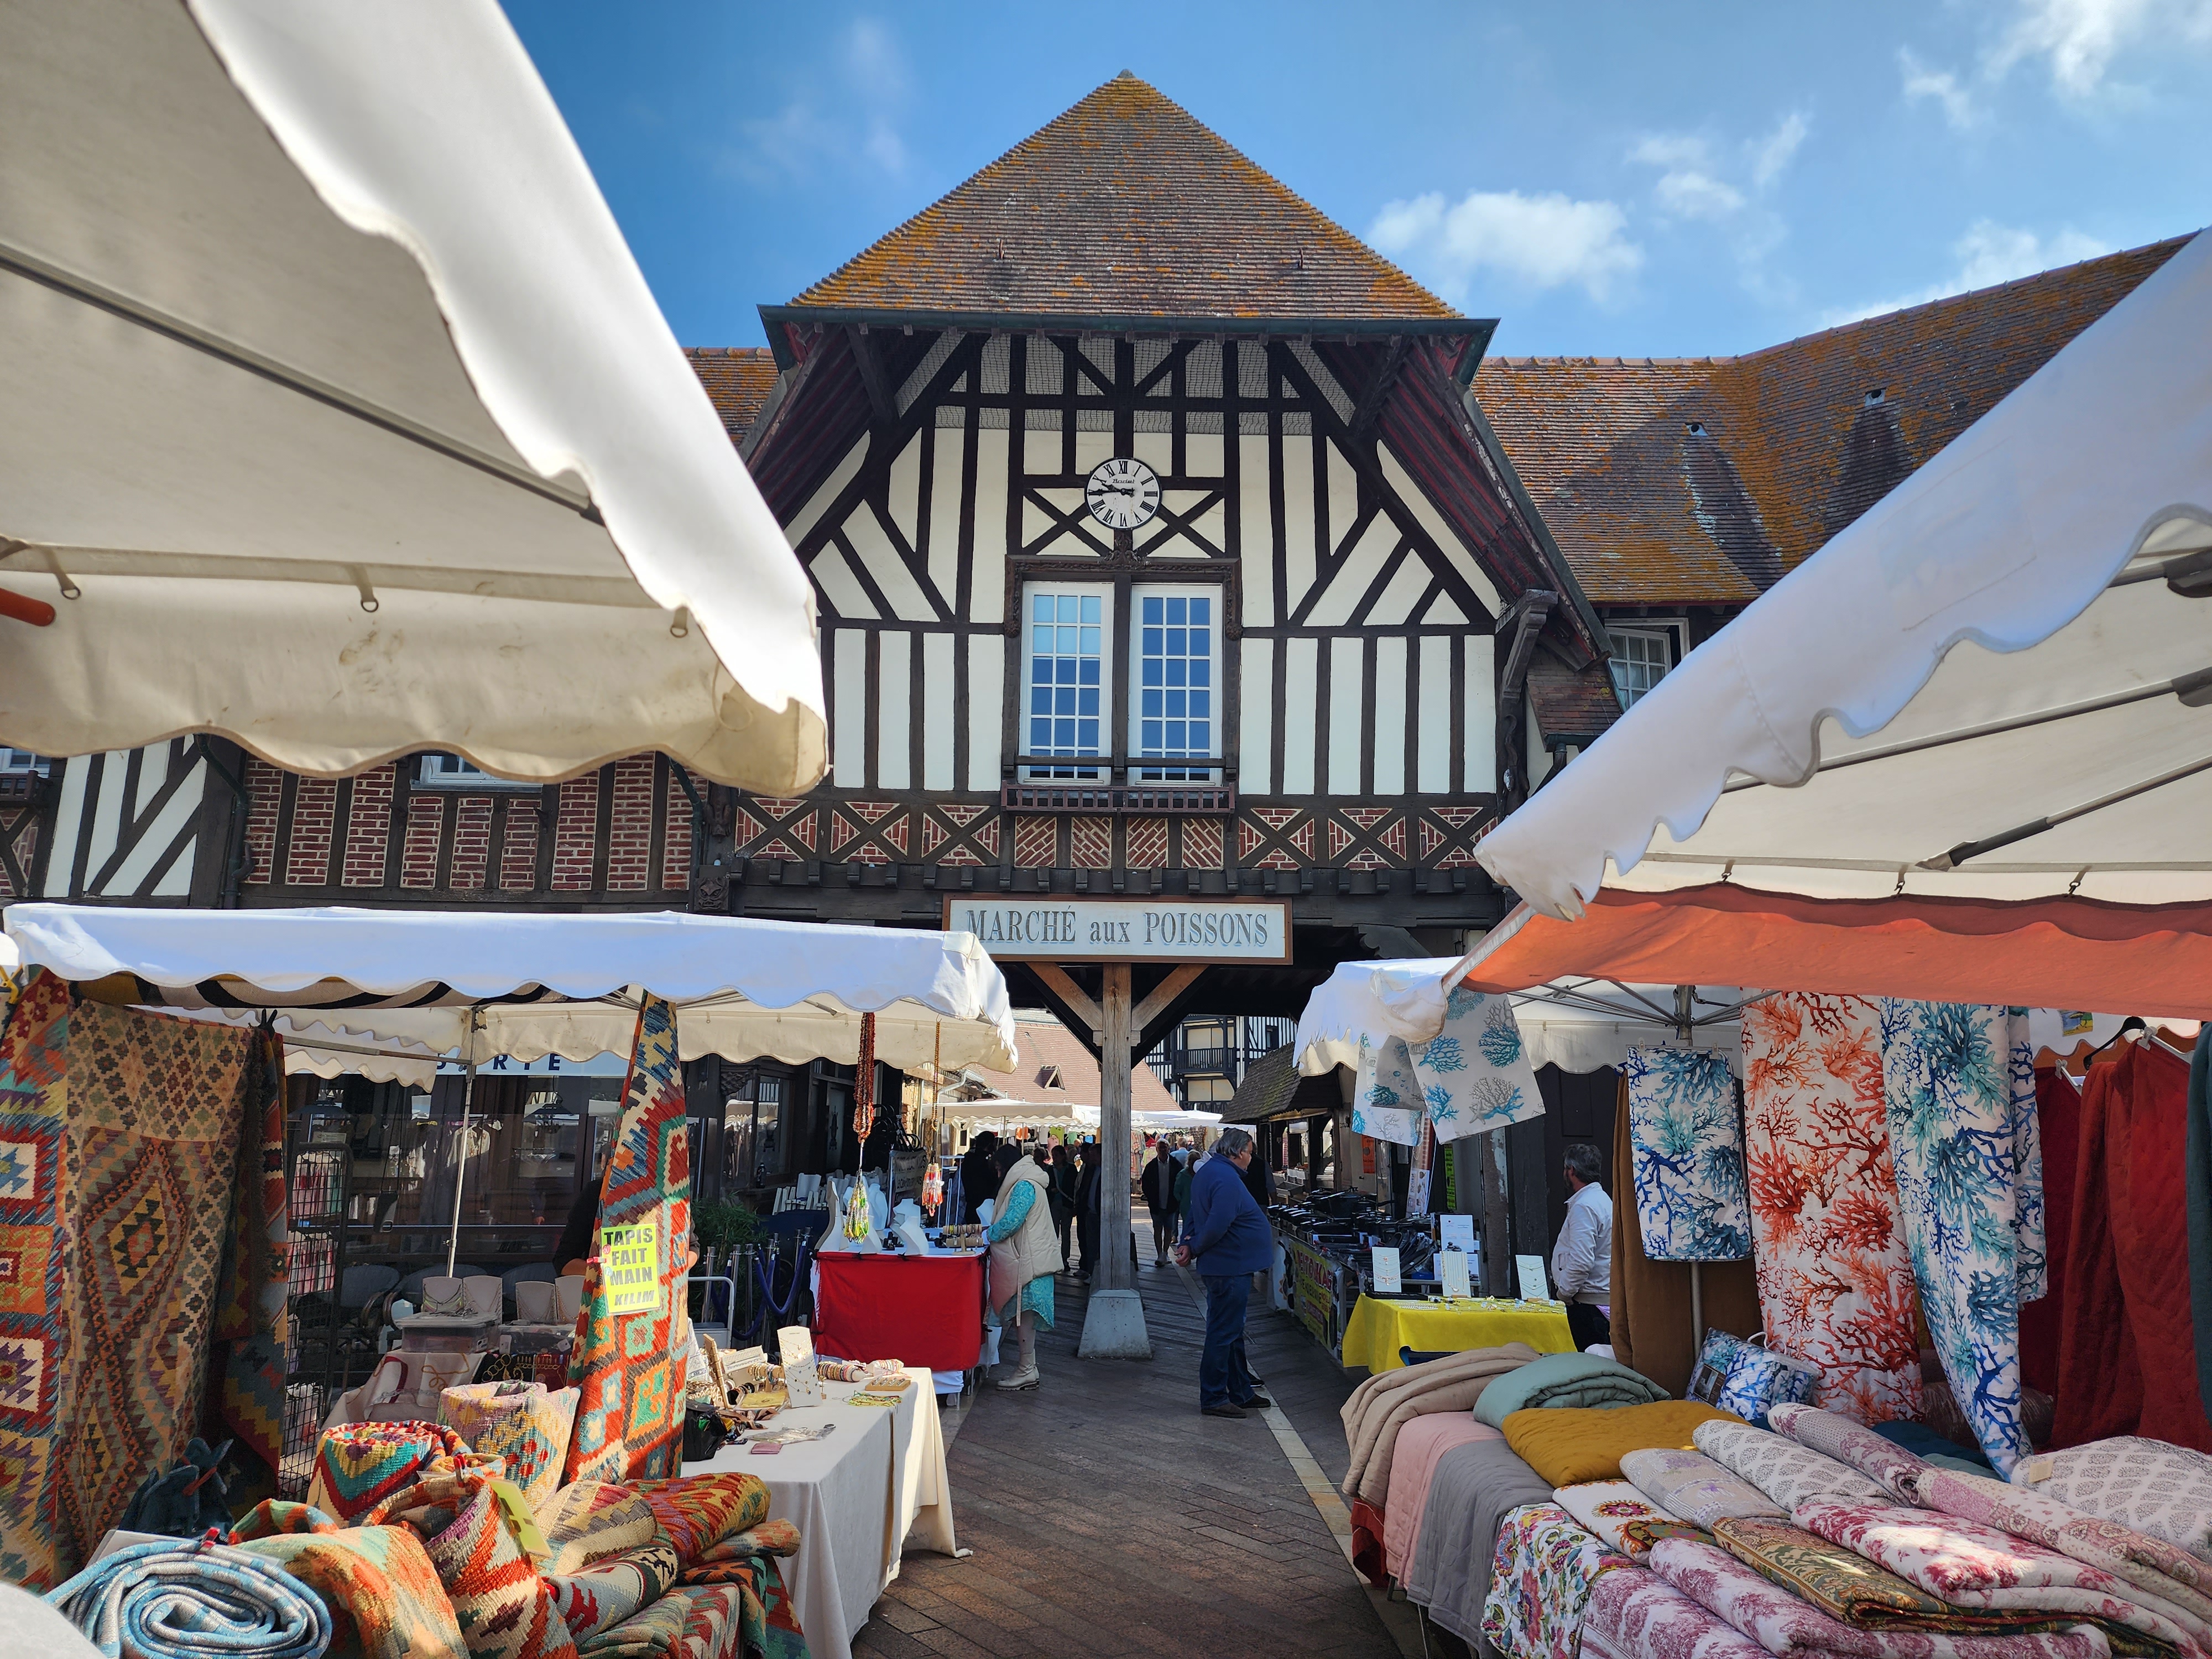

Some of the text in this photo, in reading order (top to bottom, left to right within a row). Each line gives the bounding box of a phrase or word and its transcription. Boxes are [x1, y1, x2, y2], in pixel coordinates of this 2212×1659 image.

[1118, 461, 1128, 474] XII
[966, 905, 1269, 946] MARCHÉ aux POISSONS
[604, 1228, 653, 1246] TAPIS
[612, 1248, 647, 1266] FAIT
[609, 1266, 653, 1286] MAIN
[614, 1290, 654, 1306] KILIM
